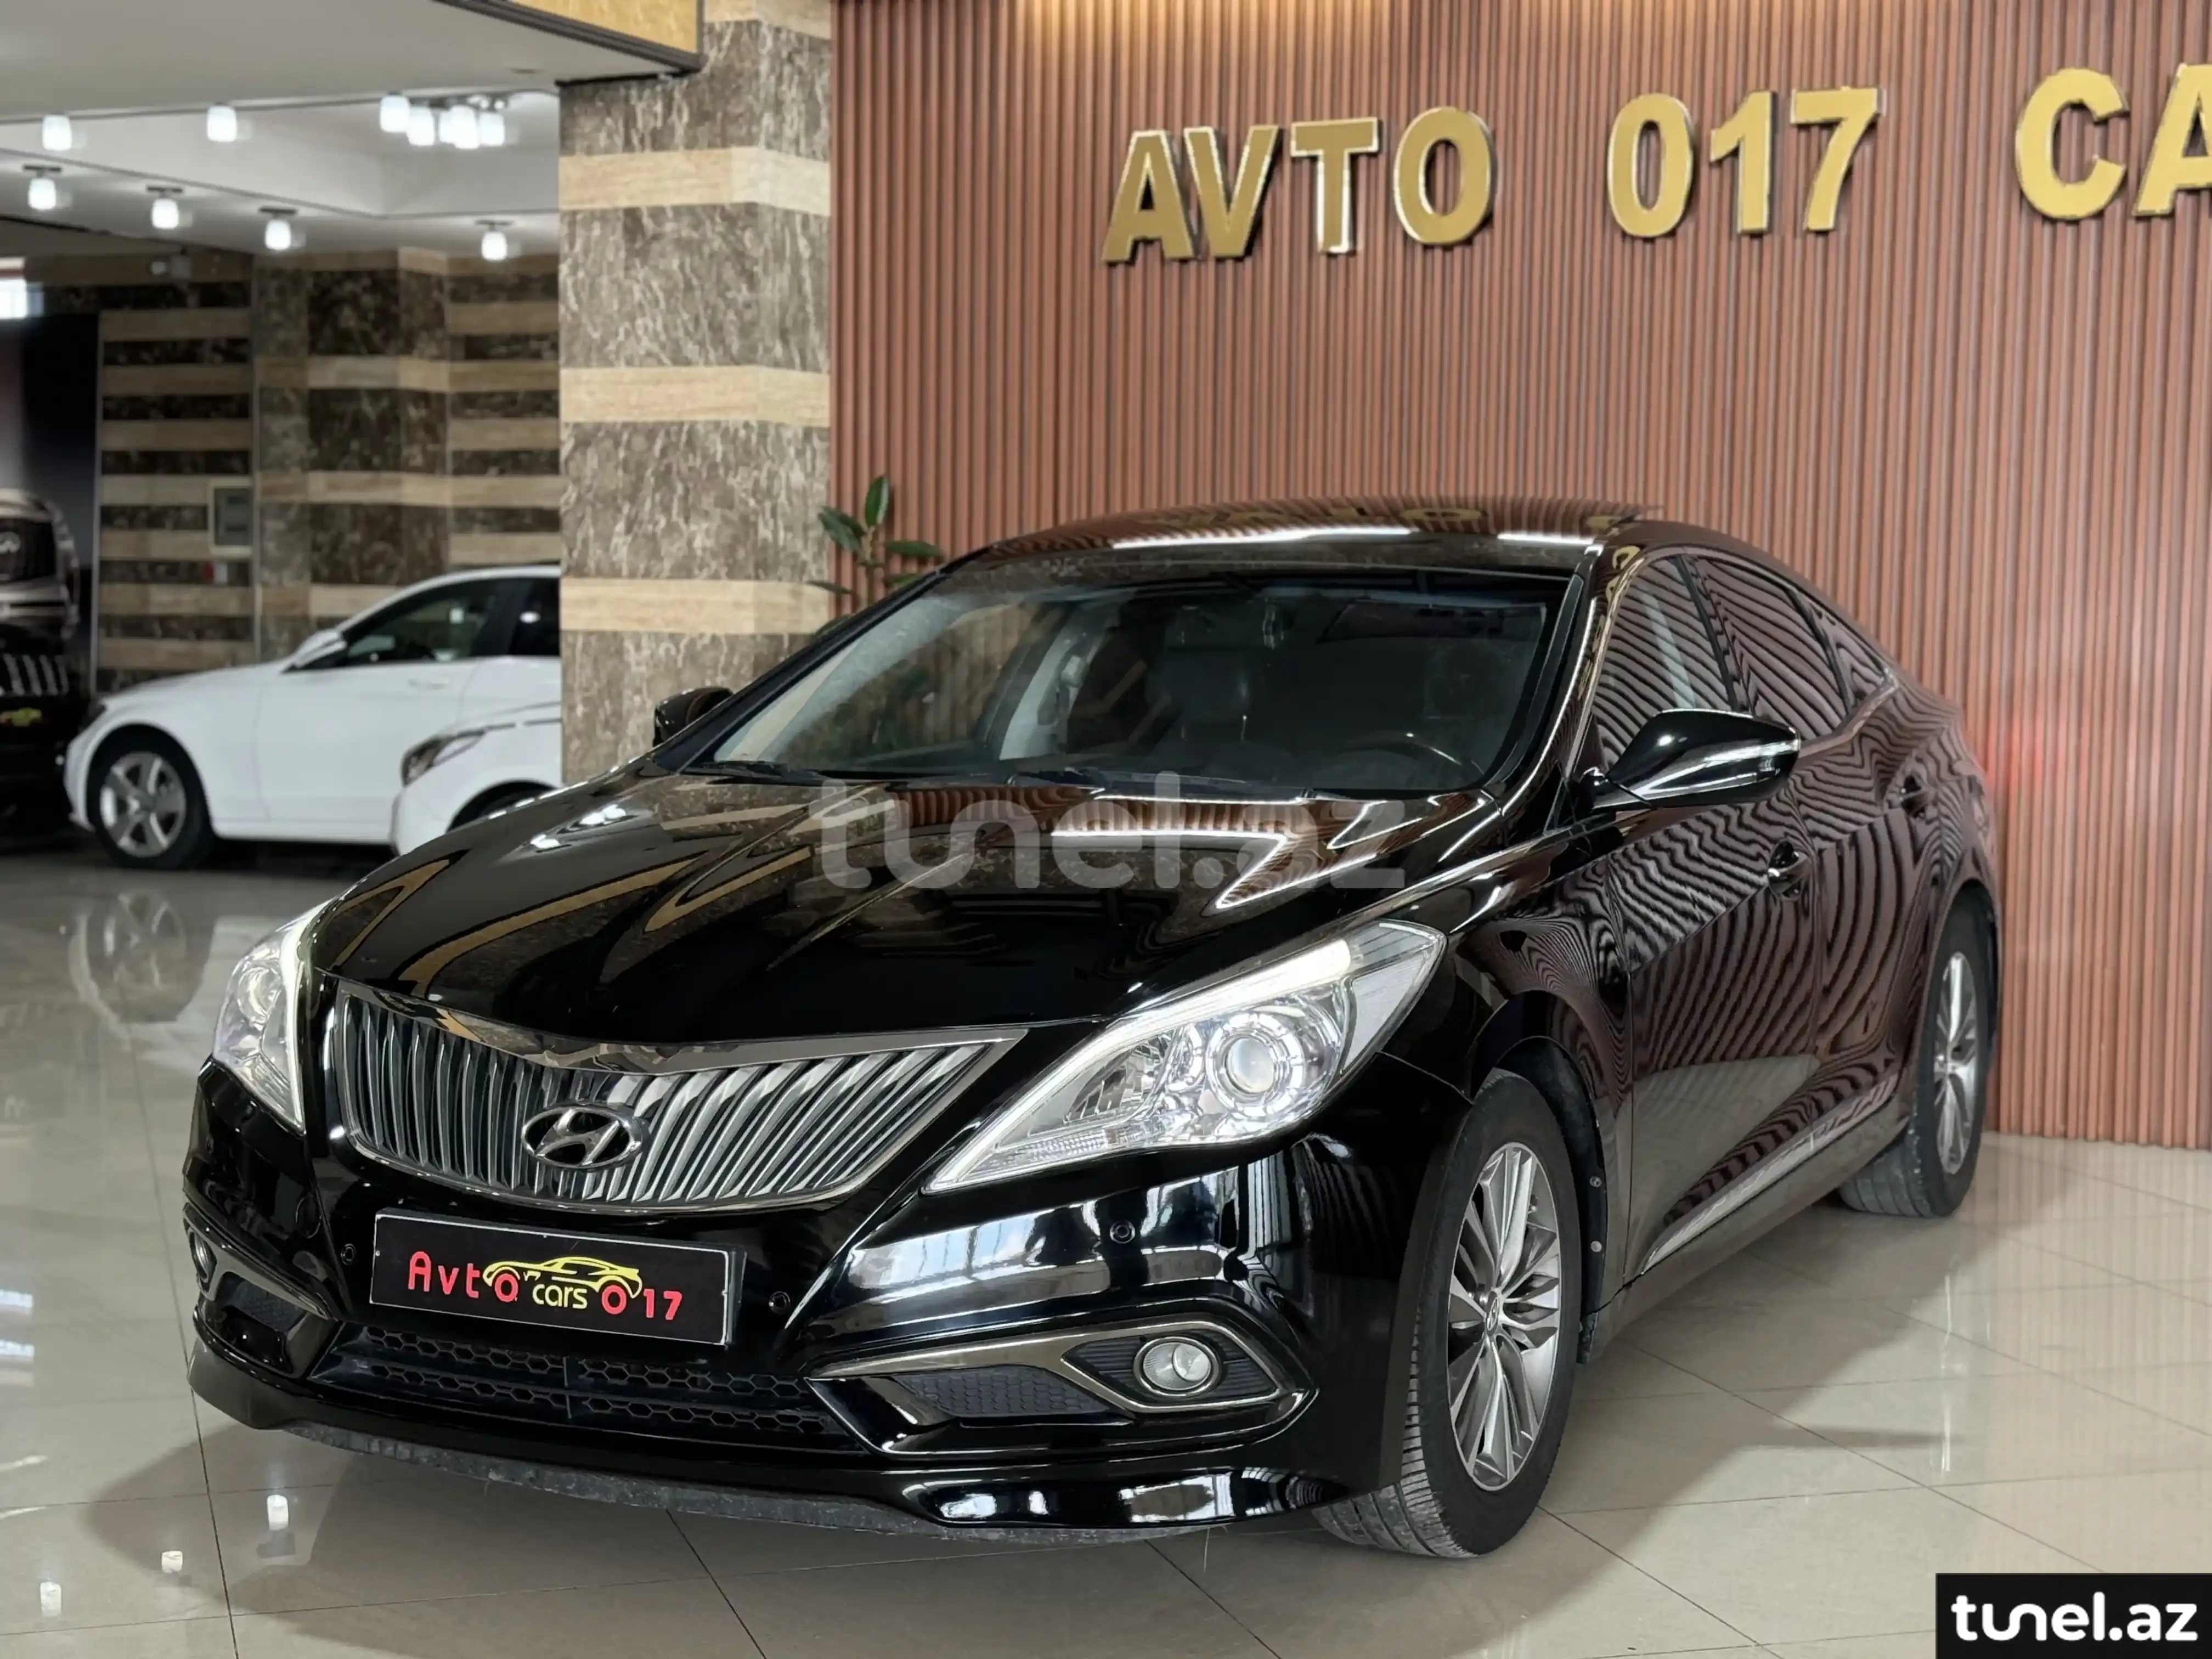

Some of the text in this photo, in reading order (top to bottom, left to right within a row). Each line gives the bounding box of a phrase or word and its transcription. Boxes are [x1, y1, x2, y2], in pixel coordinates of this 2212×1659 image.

[1102, 106, 1494, 263] AVTO
[1606, 86, 1883, 236] 017
[408, 1251, 518, 1302] Avto
[532, 1283, 588, 1309] cars
